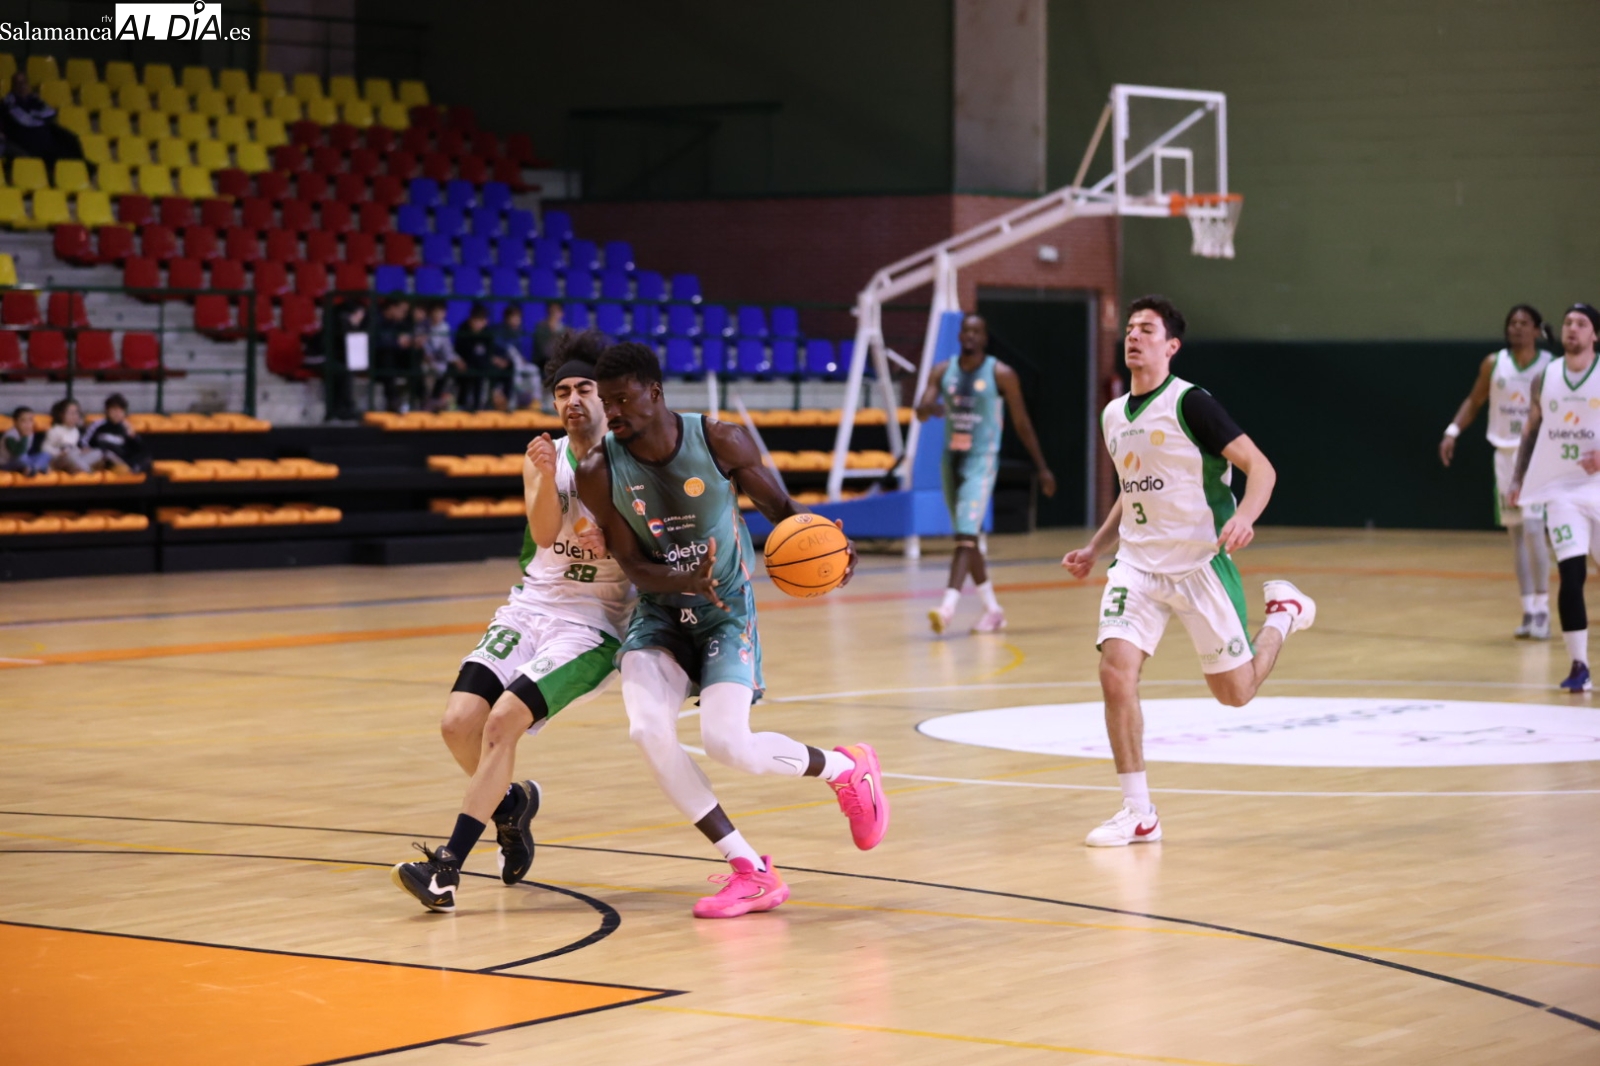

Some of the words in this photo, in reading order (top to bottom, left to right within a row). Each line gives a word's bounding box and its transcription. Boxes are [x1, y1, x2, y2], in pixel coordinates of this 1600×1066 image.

[1548, 428, 1595, 440] blendio
[1560, 443, 1579, 460] 33
[1121, 475, 1164, 493] lendio
[1132, 502, 1147, 525] 3
[1553, 523, 1573, 544] 33
[1103, 586, 1128, 618] 3
